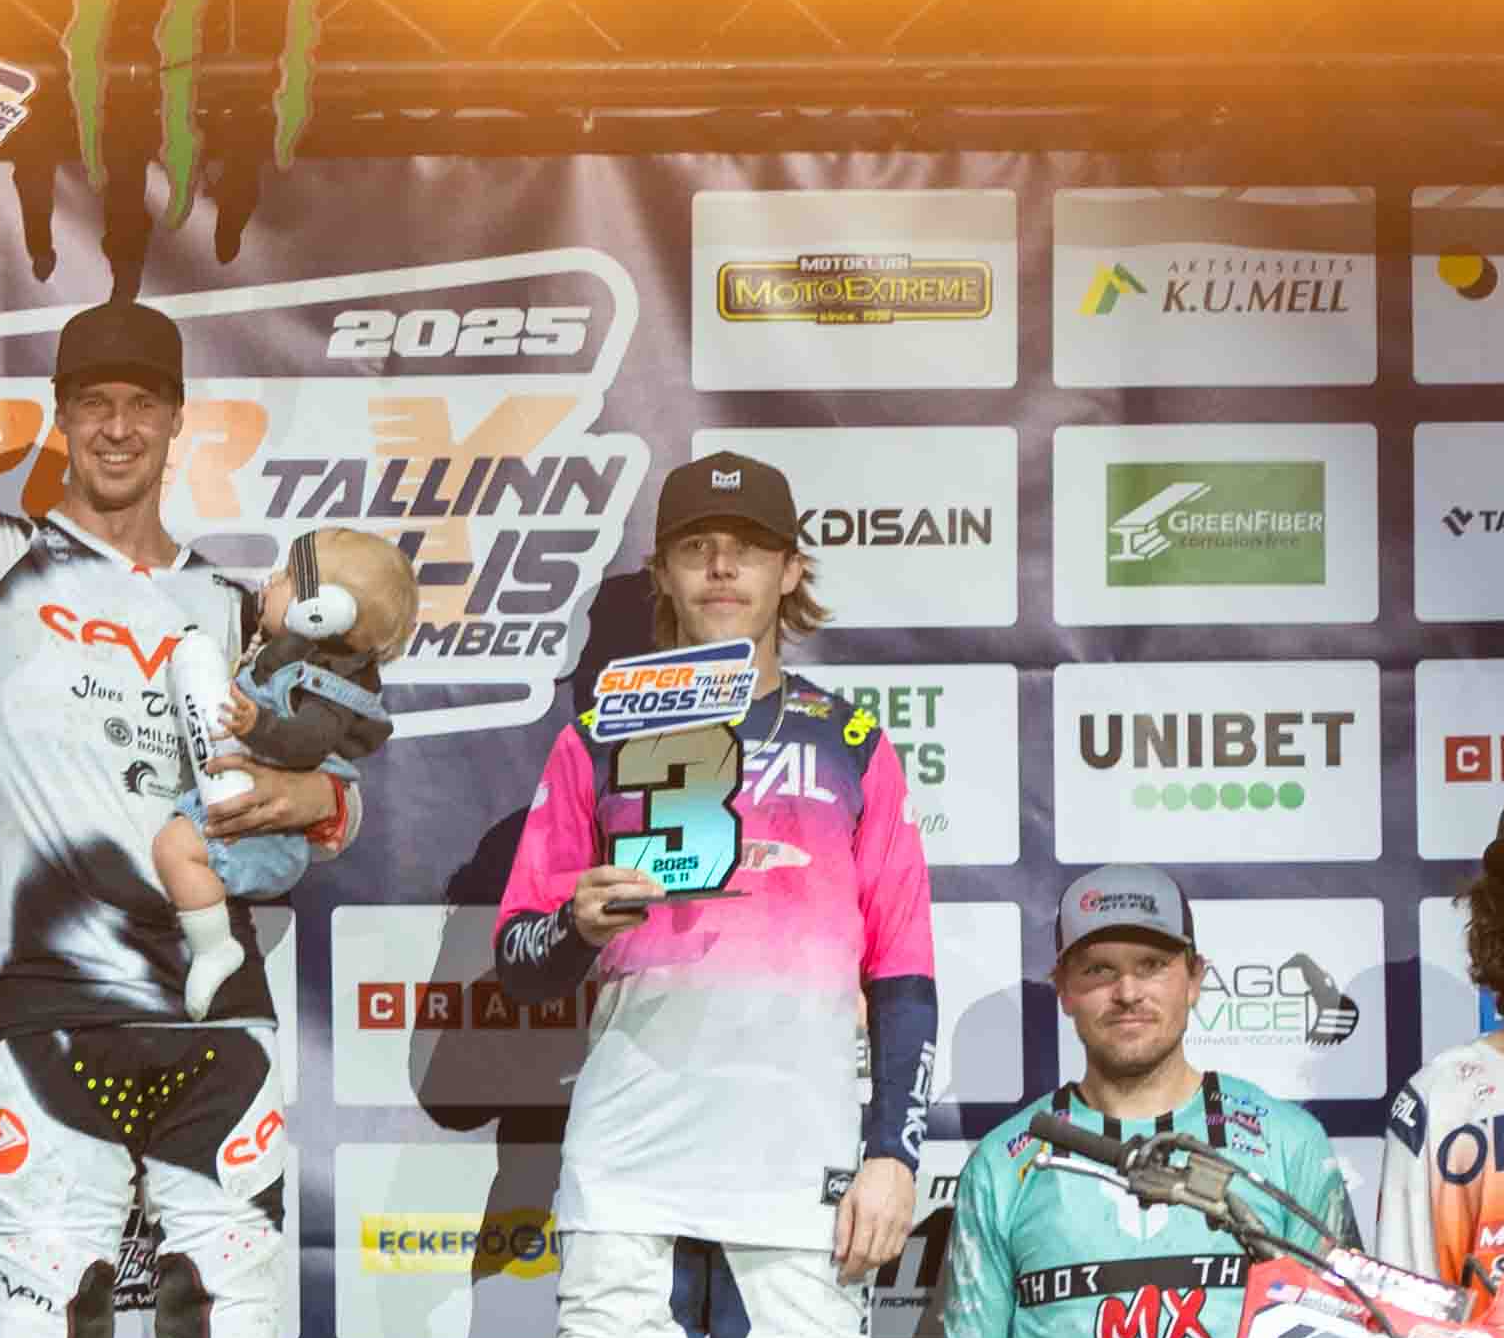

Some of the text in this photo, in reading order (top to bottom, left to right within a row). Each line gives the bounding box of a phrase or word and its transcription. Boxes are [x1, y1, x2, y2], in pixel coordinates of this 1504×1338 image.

[1167, 258, 1355, 274] AKTSIASELTS
[1162, 277, 1349, 314] K.U.MELL
[327, 306, 591, 359] 2025
[261, 456, 626, 519] TALLINN
[1167, 509, 1324, 535] GREENFIBER
[596, 667, 754, 694] SUPER TALLINN
[600, 682, 750, 717] CROSS 14-15
[1078, 711, 1356, 770] UNIBET
[651, 855, 700, 874] 2025
[367, 988, 569, 1022] CRAM
